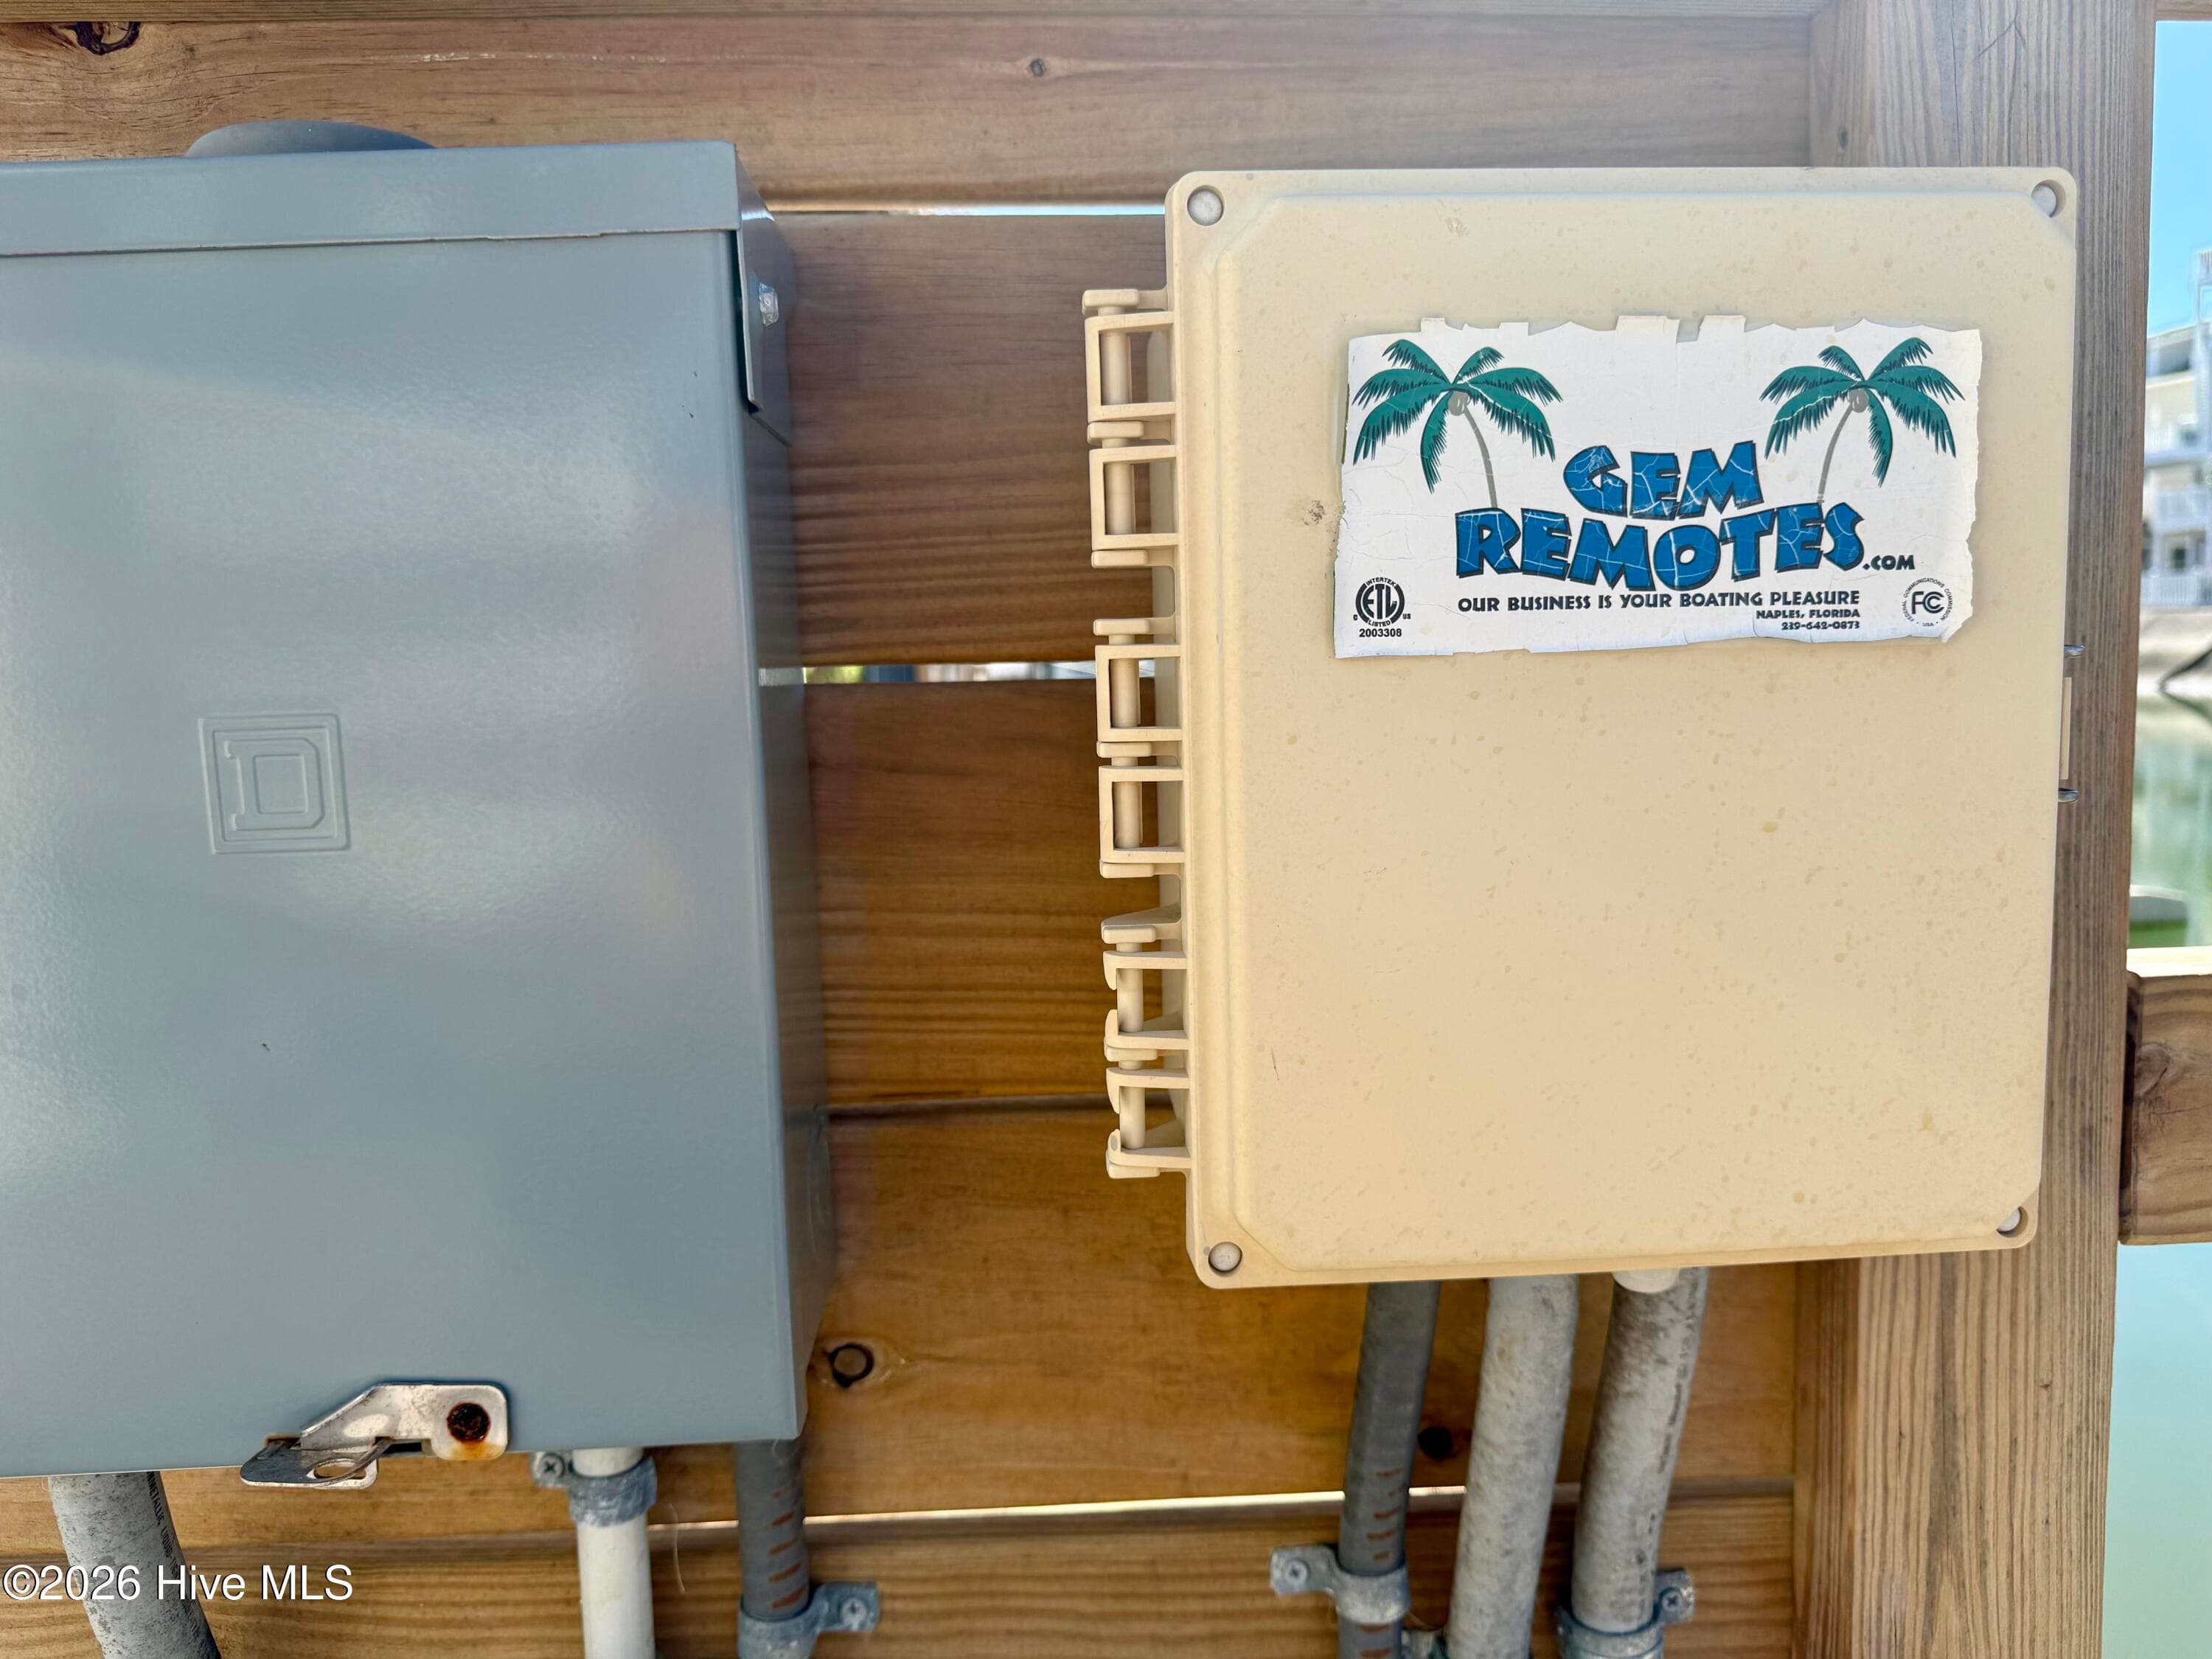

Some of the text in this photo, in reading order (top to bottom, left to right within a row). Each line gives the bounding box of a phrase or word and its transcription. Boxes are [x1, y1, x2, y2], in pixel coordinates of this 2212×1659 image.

[1562, 439, 1764, 521] GEM
[1455, 502, 1865, 591] REMOTES
[1366, 577, 1397, 587] INTERTEK
[1903, 577, 1944, 598] COMMUNICATIONS
[1362, 583, 1398, 620] ETL
[1458, 590, 1860, 612] OUR BUSINESS IS YOUR BOATING PLEASURE
[1911, 591, 1945, 615] FCC
[1368, 619, 1391, 627] LISTED
[1756, 609, 1860, 619] NAPLES, FLORIDA
[1359, 627, 1402, 638] 2003308
